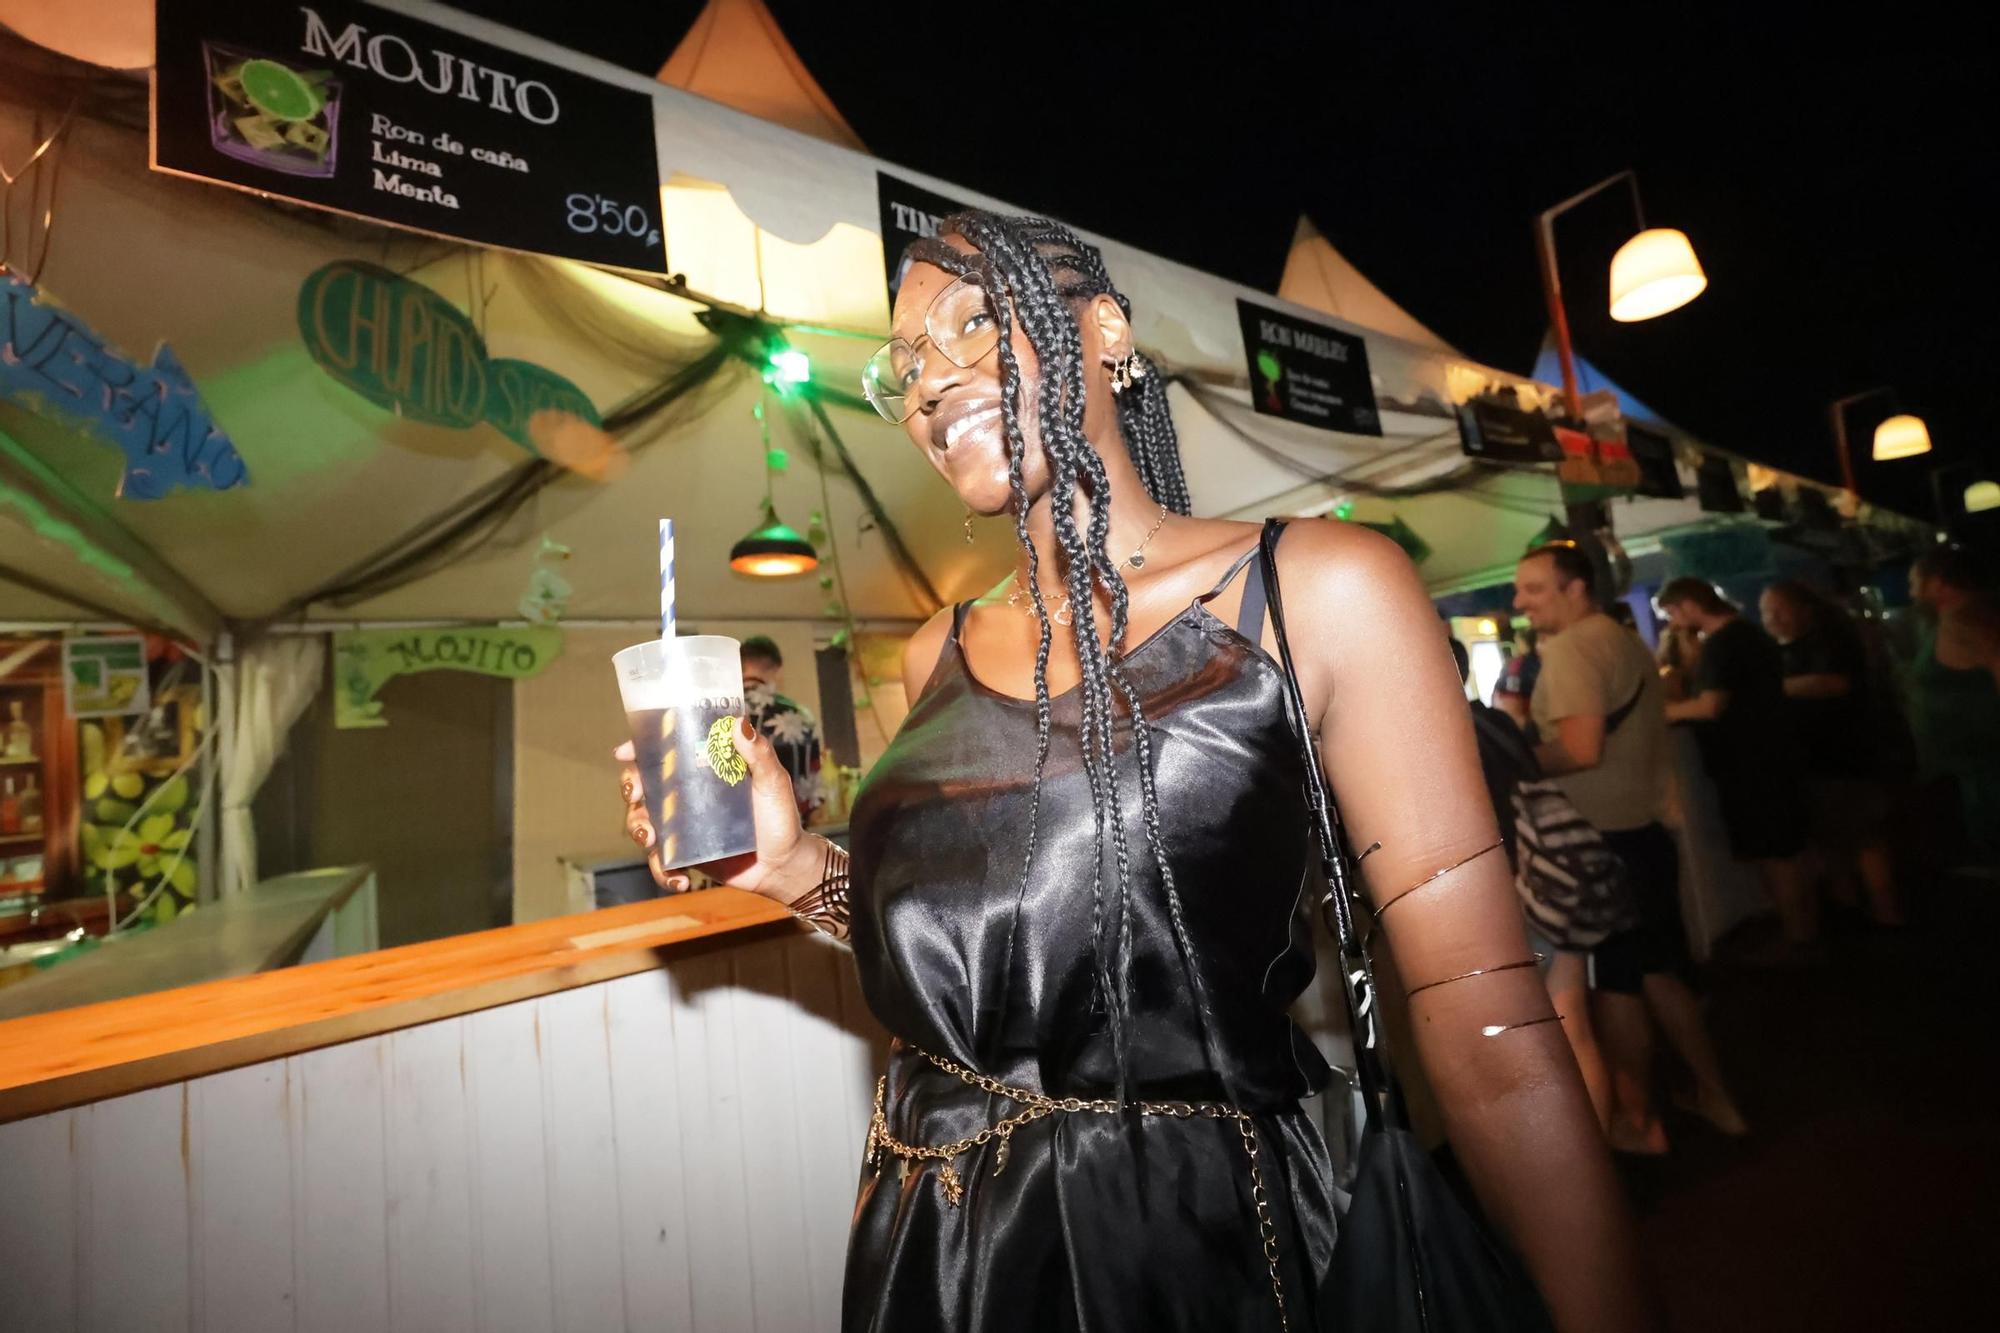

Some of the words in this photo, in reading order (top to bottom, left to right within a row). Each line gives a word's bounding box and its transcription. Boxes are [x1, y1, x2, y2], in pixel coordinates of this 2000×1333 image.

[301, 7, 560, 125] MOJITO
[371, 113, 425, 145] Ron
[431, 133, 464, 155] de
[470, 148, 529, 173] caña
[372, 141, 443, 178] Lima
[372, 168, 460, 209] Menta
[387, 637, 536, 671] MOJITO
